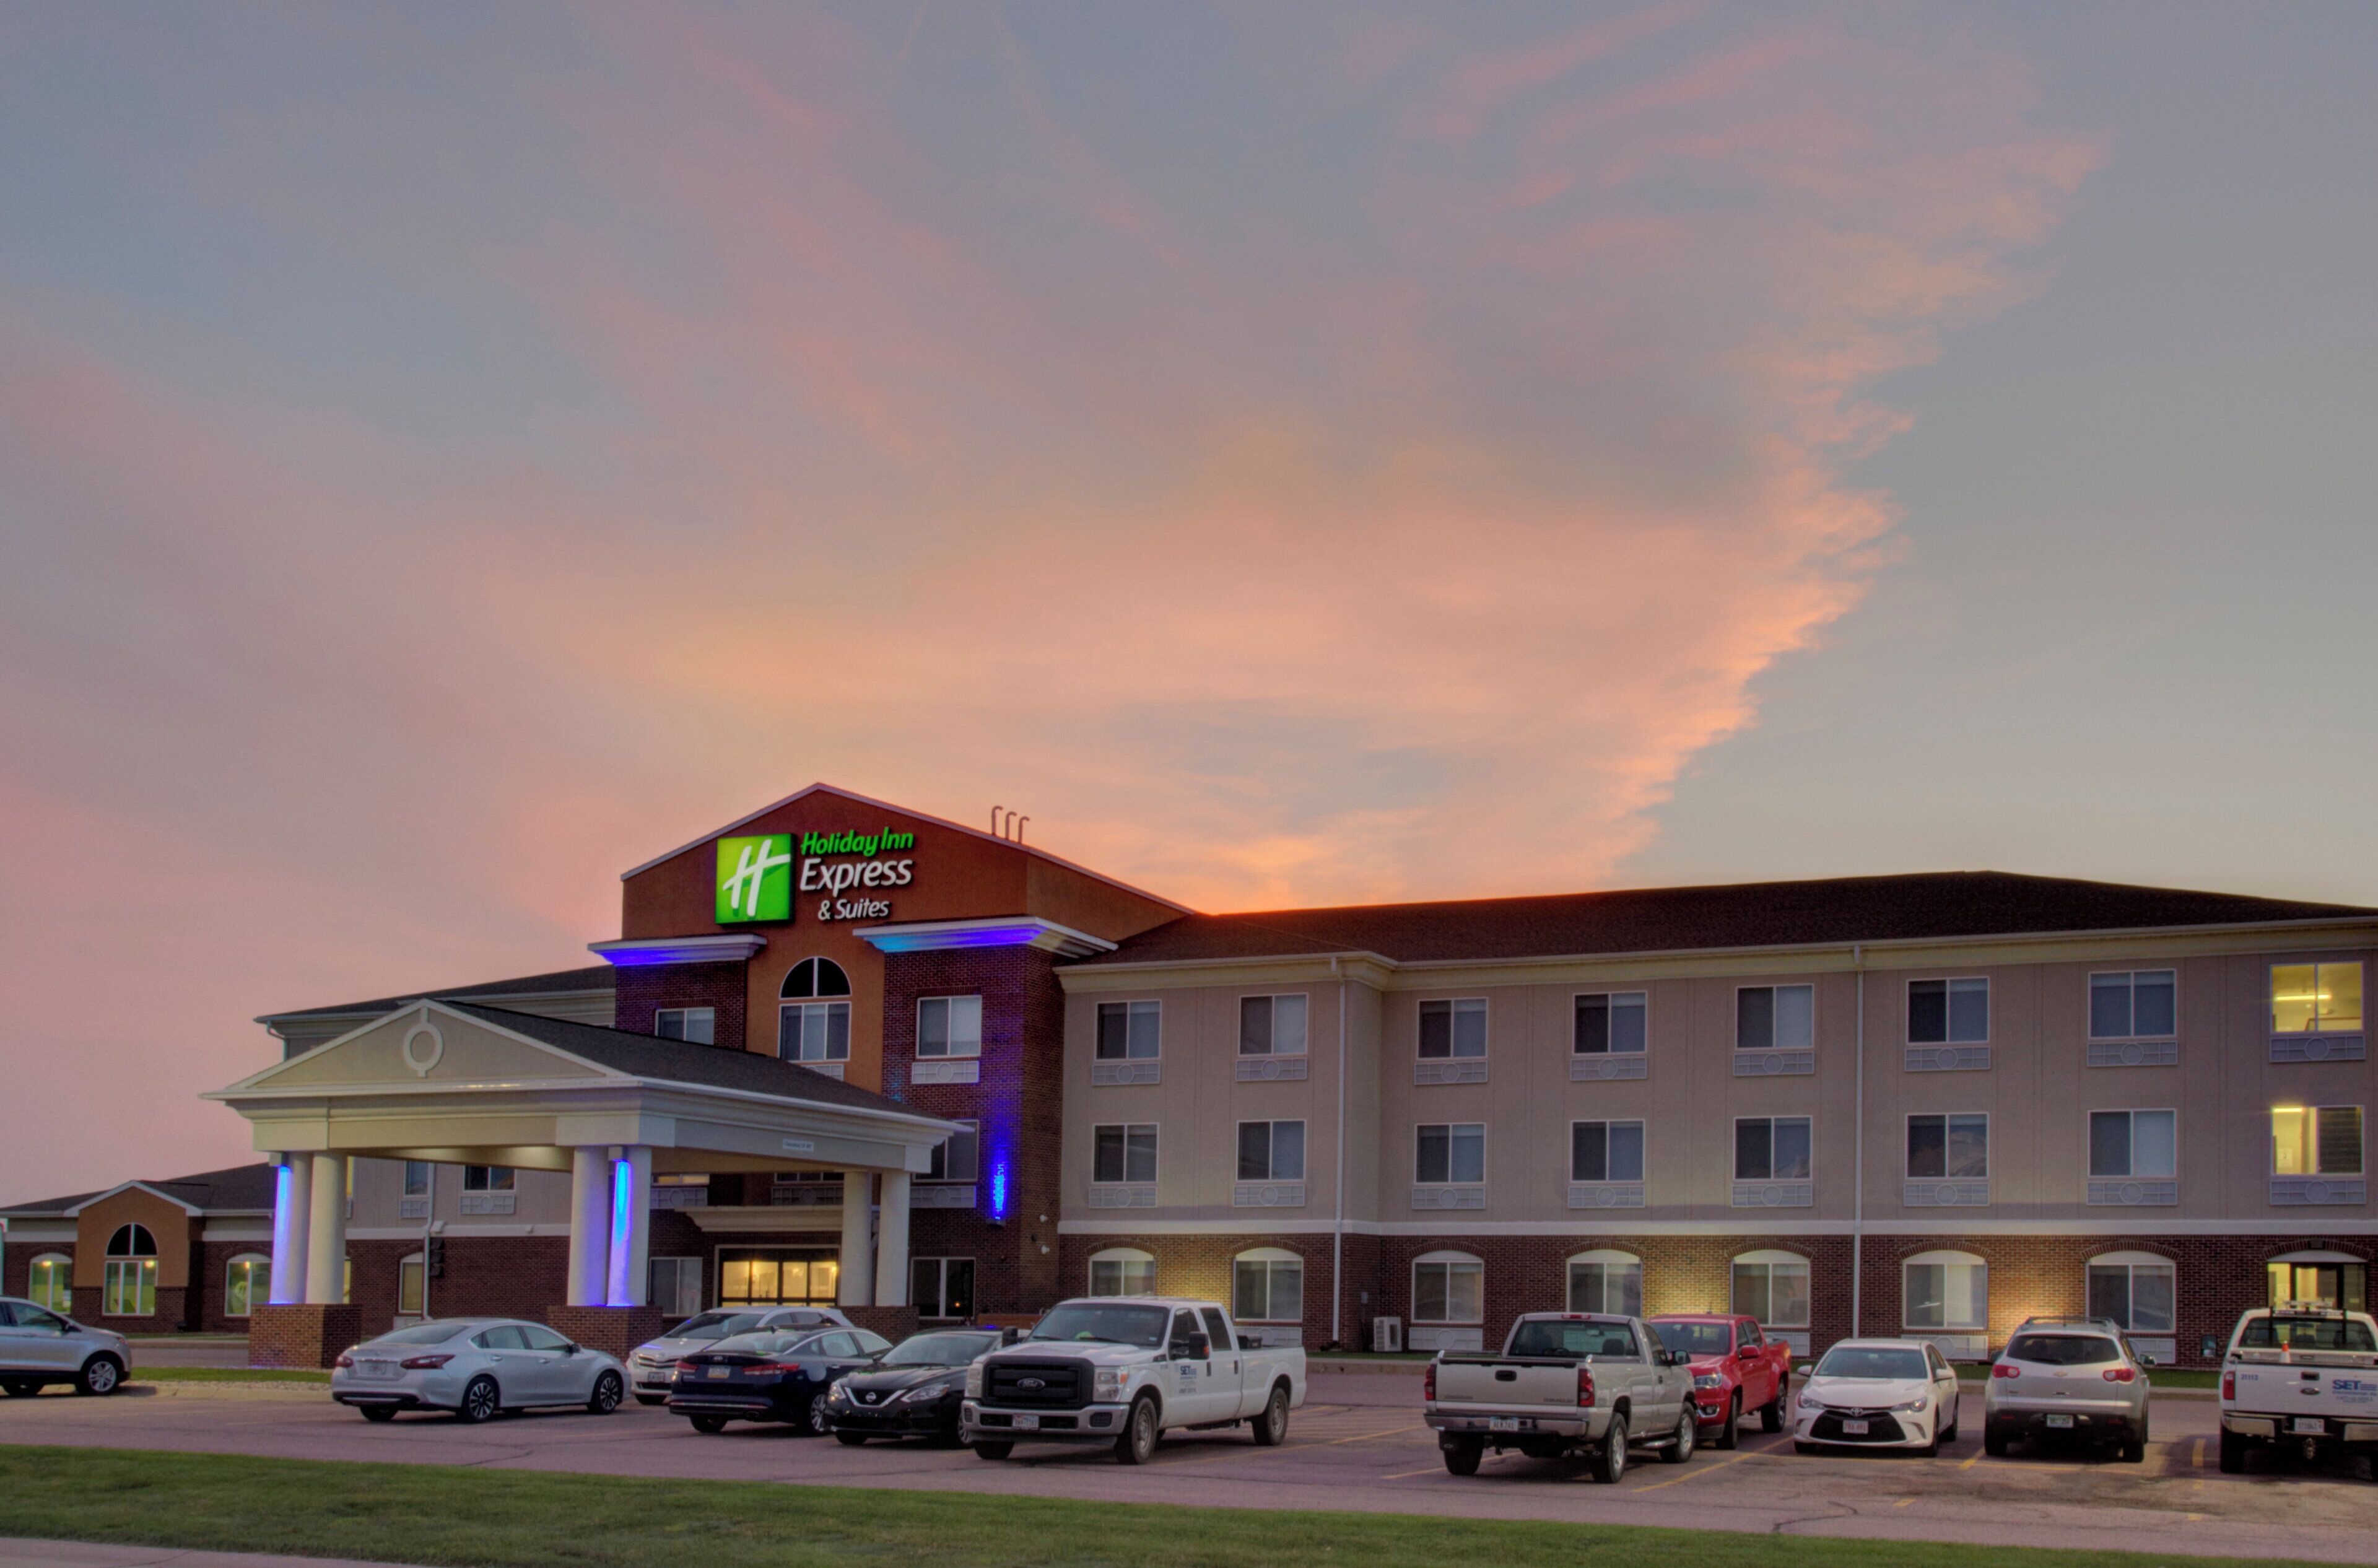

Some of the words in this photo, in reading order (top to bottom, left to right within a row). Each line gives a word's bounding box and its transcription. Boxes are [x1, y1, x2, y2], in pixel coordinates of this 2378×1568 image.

[801, 829, 879, 856] Holiday
[881, 827, 913, 850] Inn
[723, 839, 791, 917] H
[800, 858, 913, 897] Express
[818, 900, 830, 920] &
[835, 899, 889, 920] Suites
[1180, 1365, 1190, 1375] SET
[2332, 1379, 2361, 1390] SET
